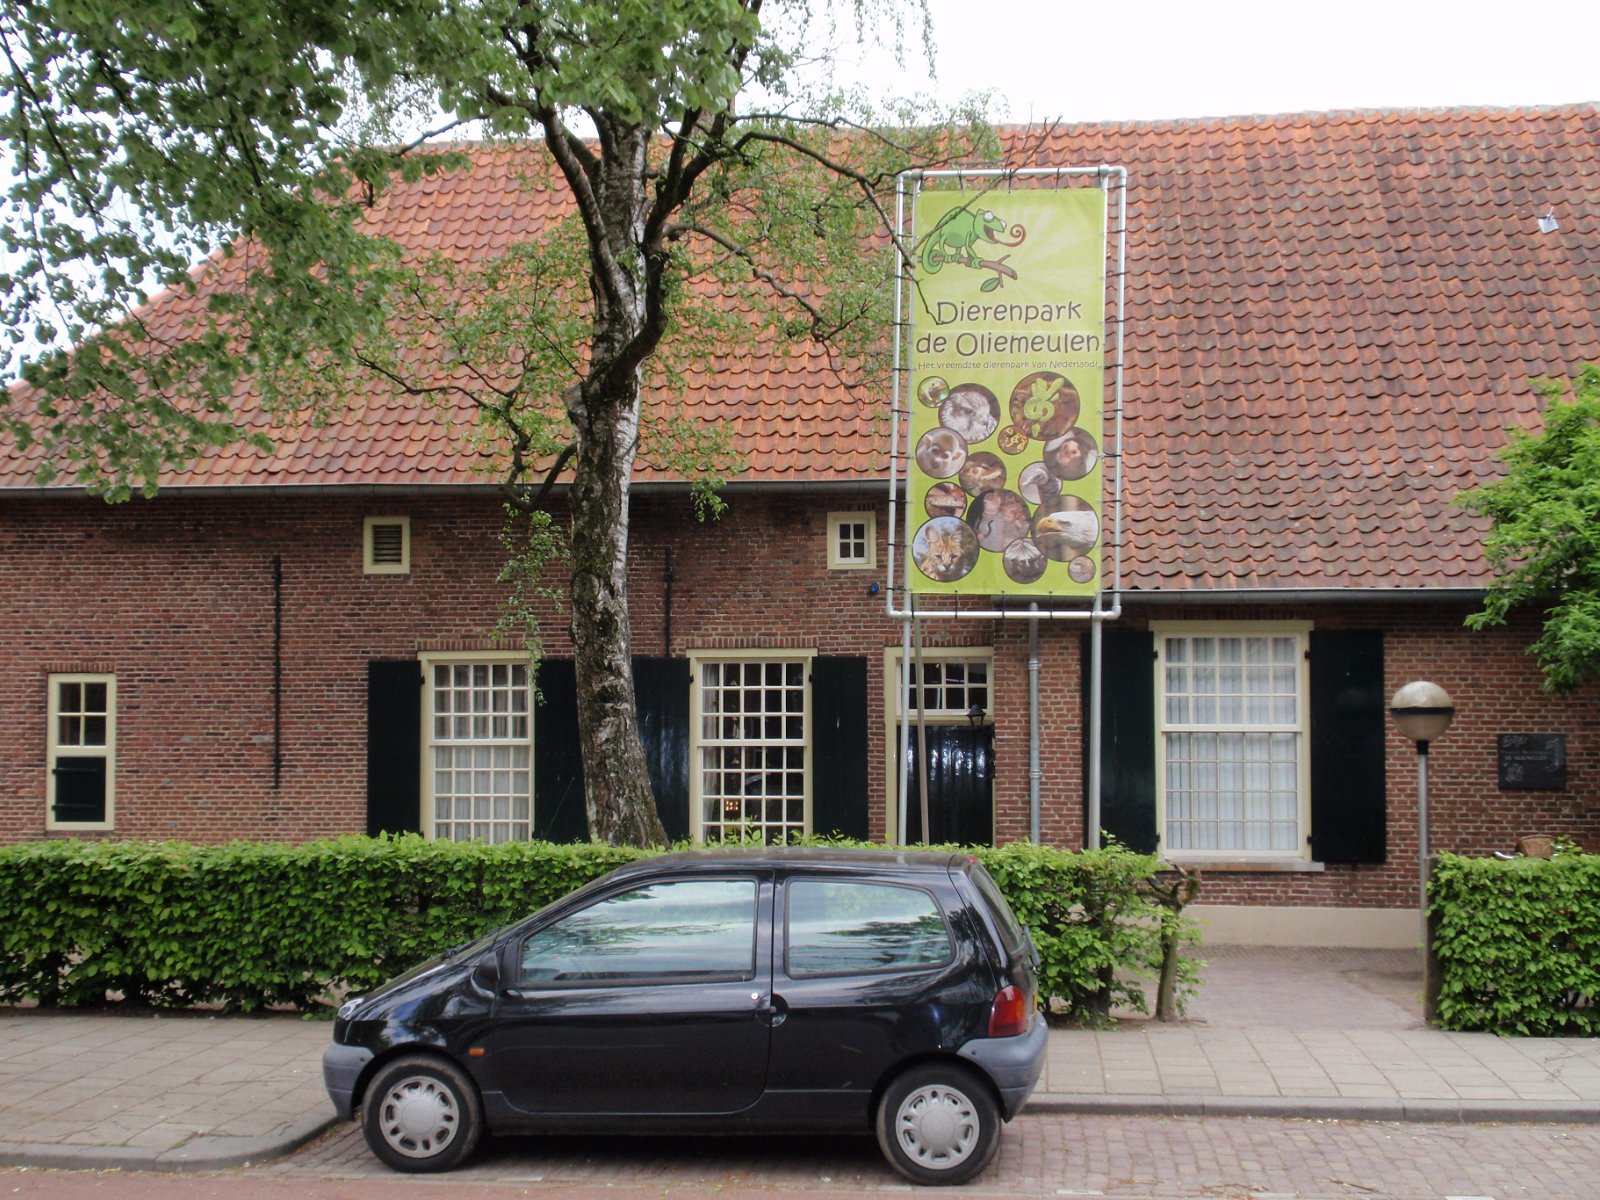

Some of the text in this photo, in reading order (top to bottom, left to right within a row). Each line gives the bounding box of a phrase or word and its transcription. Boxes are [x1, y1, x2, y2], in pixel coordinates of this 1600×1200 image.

[937, 300, 1082, 325] Dierenpark
[916, 331, 1100, 357] de Oliemeulen
[918, 361, 934, 370] Het
[983, 360, 1030, 370] dierenpark
[1049, 360, 1098, 369] Nederland!
